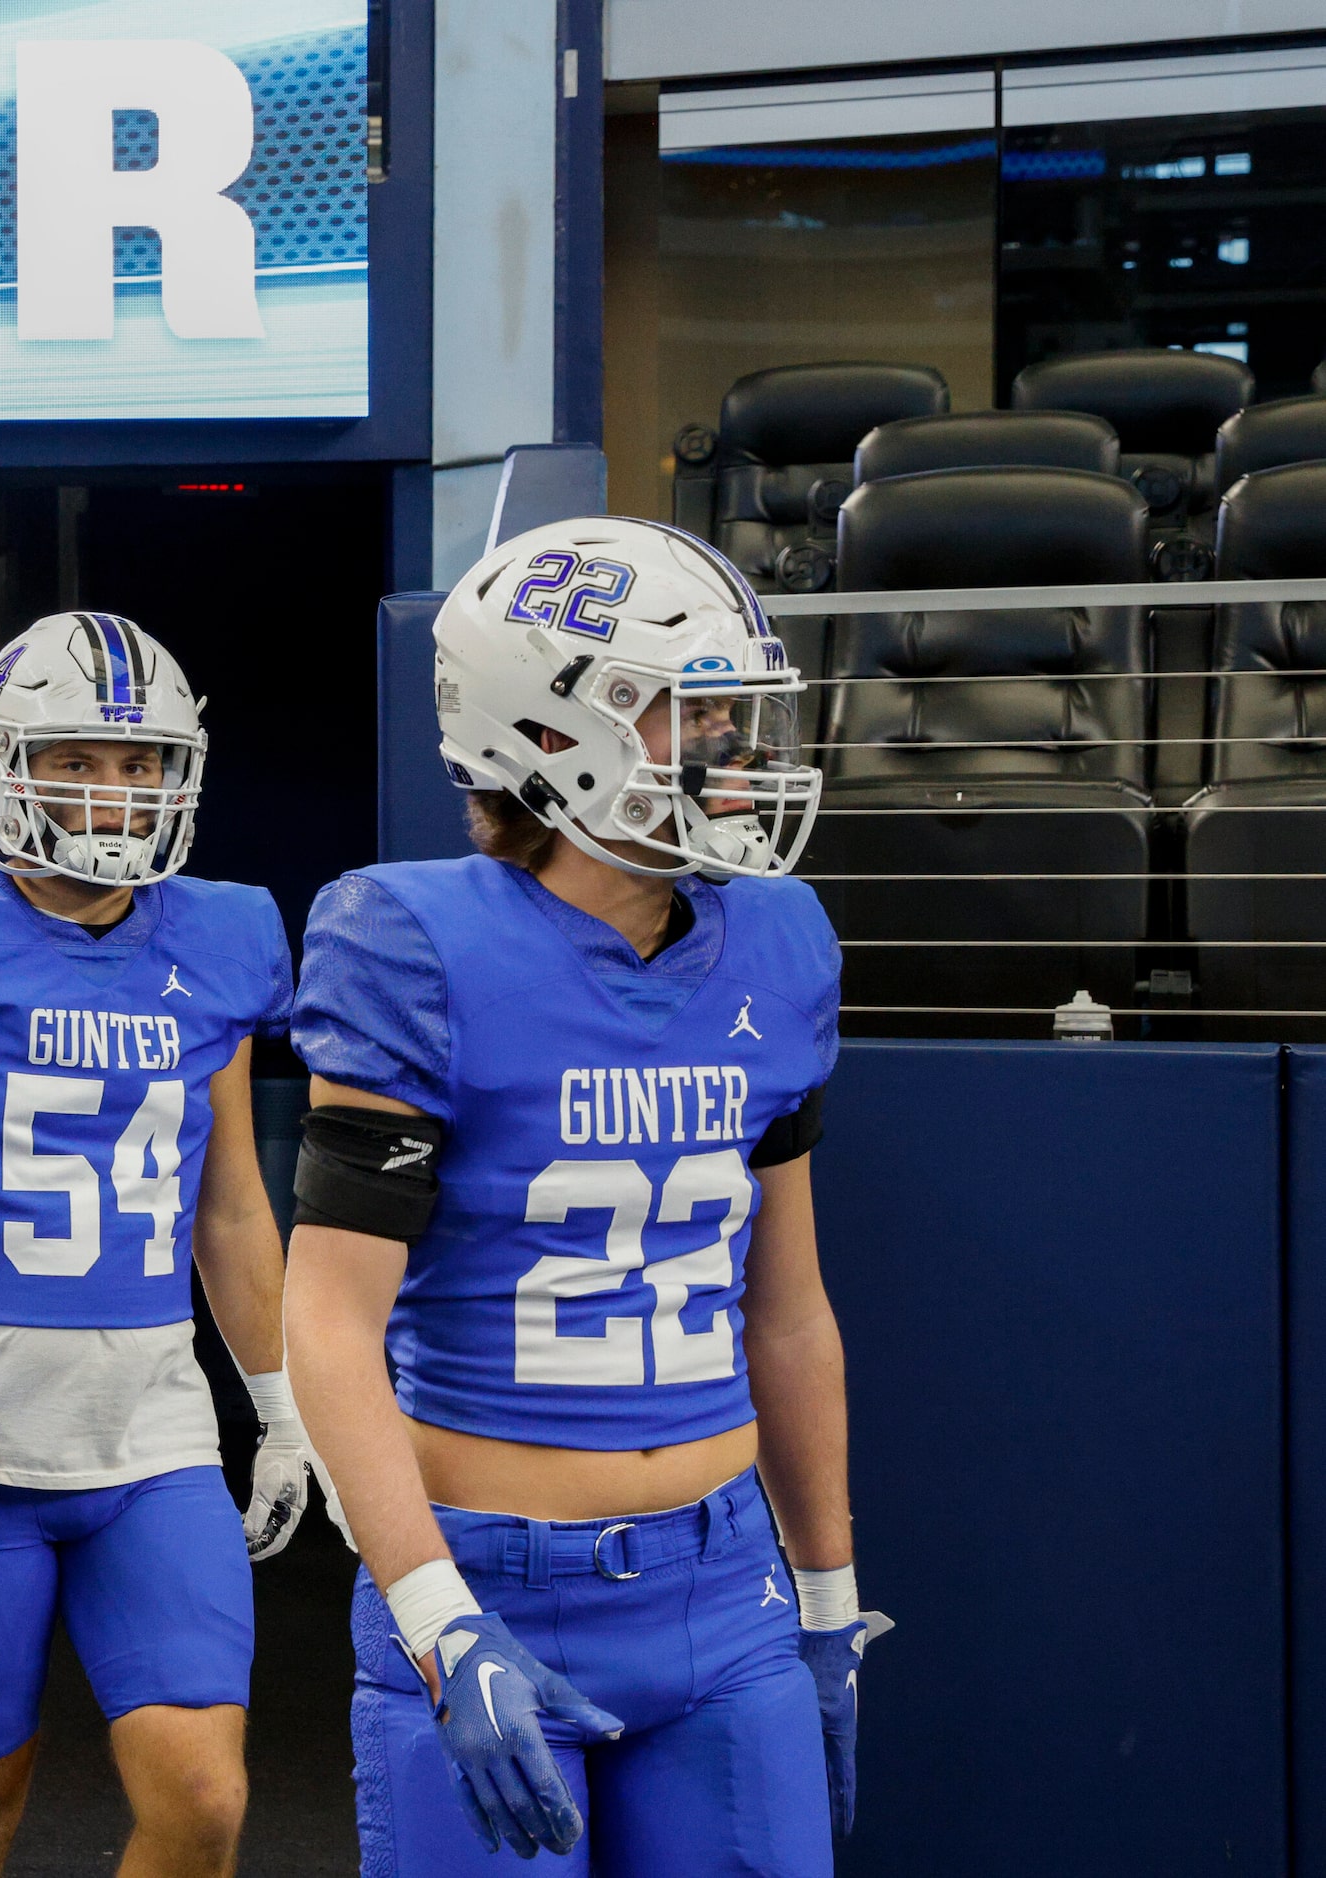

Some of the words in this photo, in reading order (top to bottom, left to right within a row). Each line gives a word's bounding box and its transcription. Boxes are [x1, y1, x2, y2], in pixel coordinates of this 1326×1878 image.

[505, 550, 637, 643] 22
[28, 1008, 181, 1071] GUNTER
[560, 1065, 749, 1145] GUNTER
[2, 1072, 186, 1277] 54
[514, 1149, 754, 1386] 22
